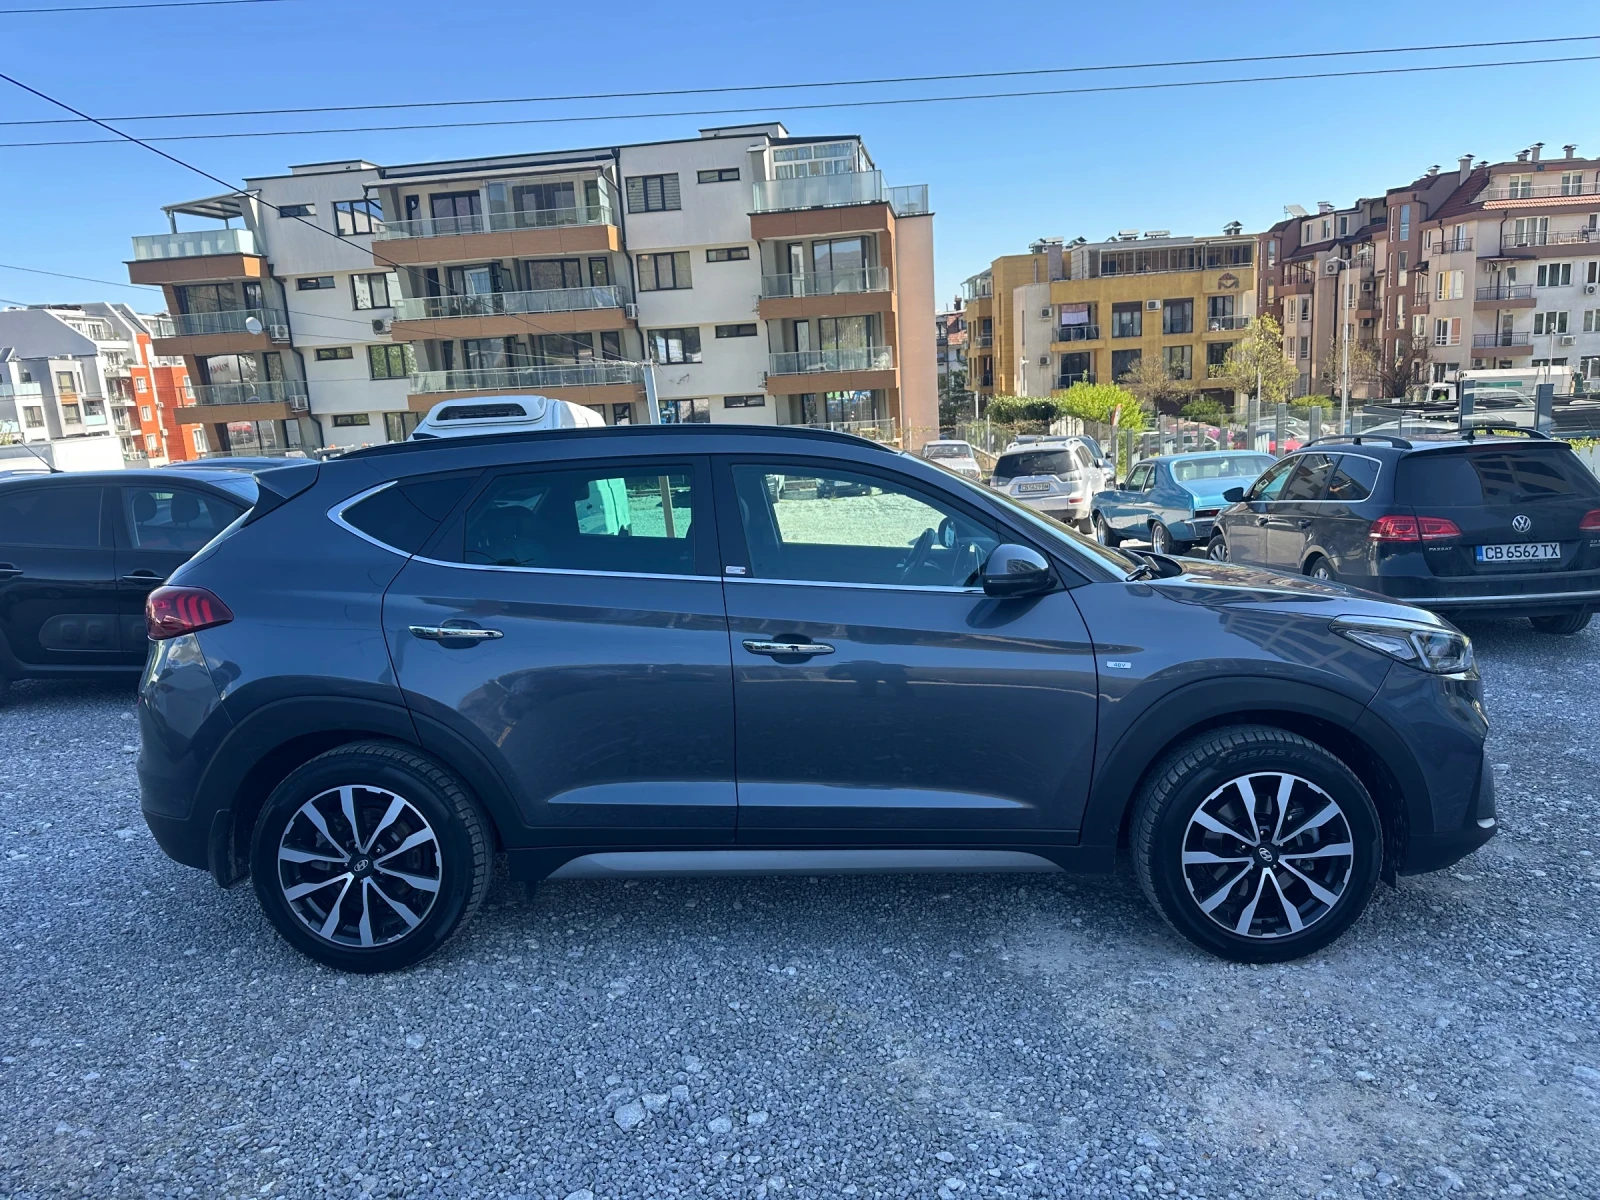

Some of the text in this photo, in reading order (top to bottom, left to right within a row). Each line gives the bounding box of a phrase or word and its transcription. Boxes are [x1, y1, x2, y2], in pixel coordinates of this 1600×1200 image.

[1485, 543, 1559, 560] CB 6562 TX
[1227, 748, 1288, 764] 225/55
